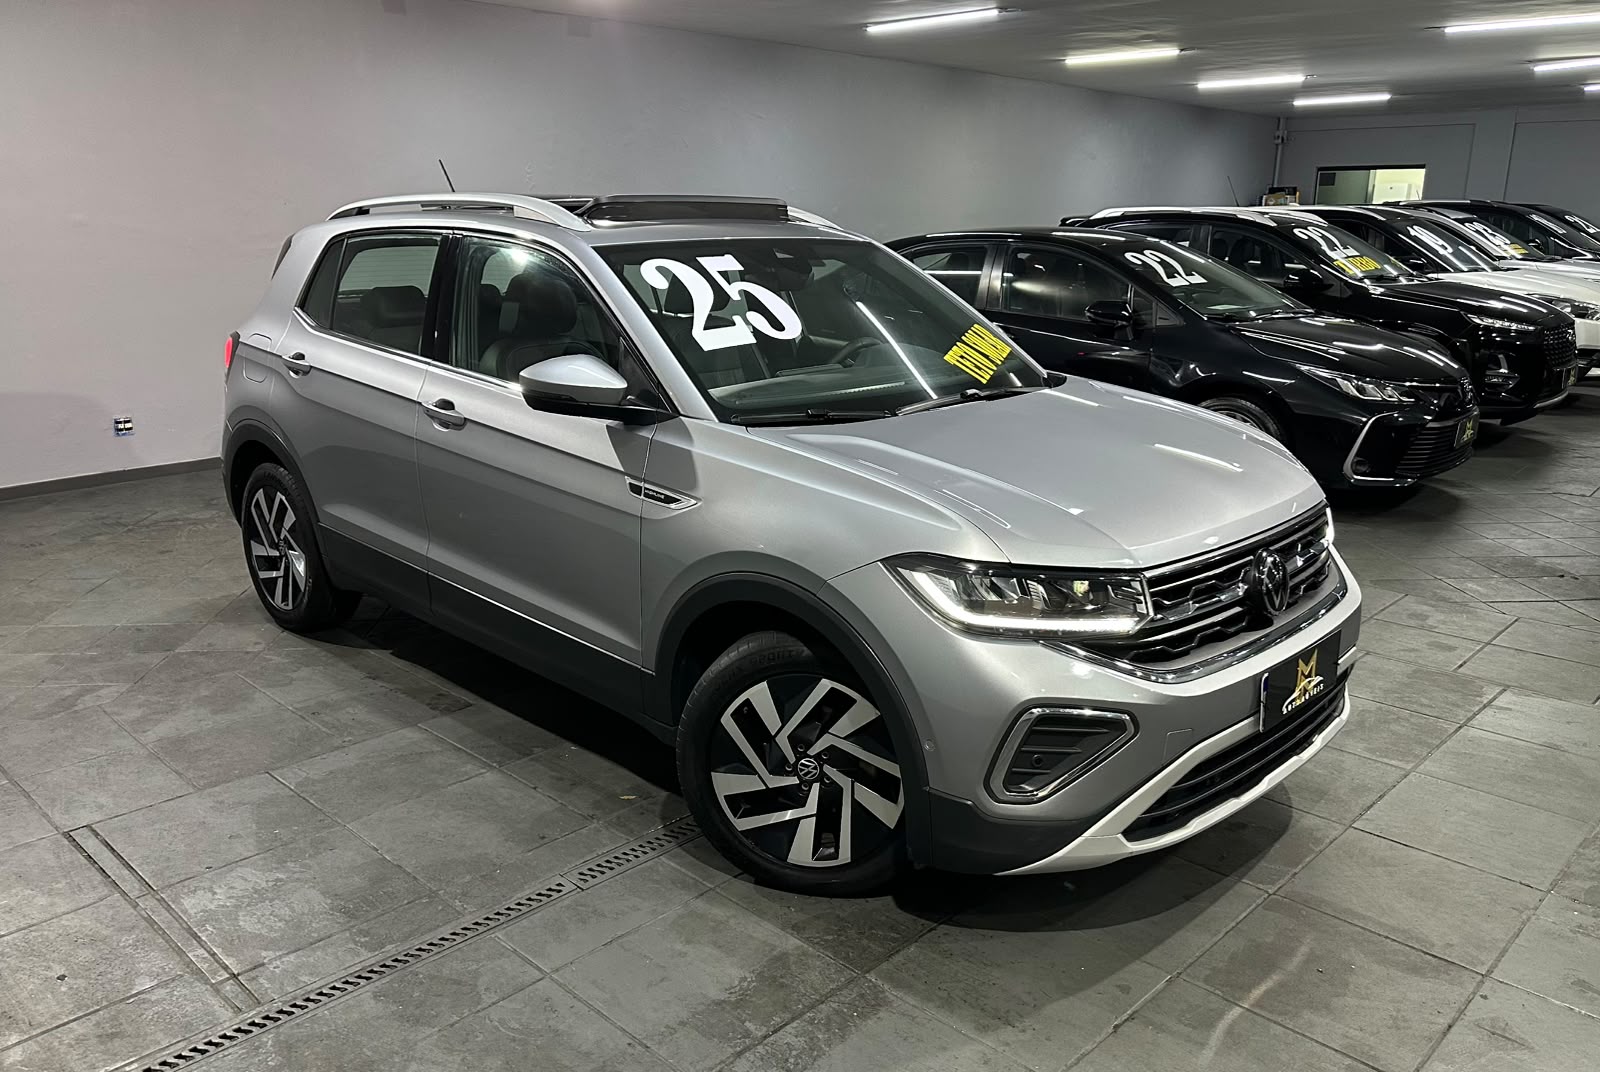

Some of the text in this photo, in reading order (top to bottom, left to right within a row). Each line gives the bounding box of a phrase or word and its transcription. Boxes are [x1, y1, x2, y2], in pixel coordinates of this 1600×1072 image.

[1293, 226, 1361, 260] 22
[1407, 225, 1454, 254] 19
[1124, 249, 1208, 287] 22
[640, 253, 802, 351] 25
[943, 323, 1012, 385] TETO SOLAR
